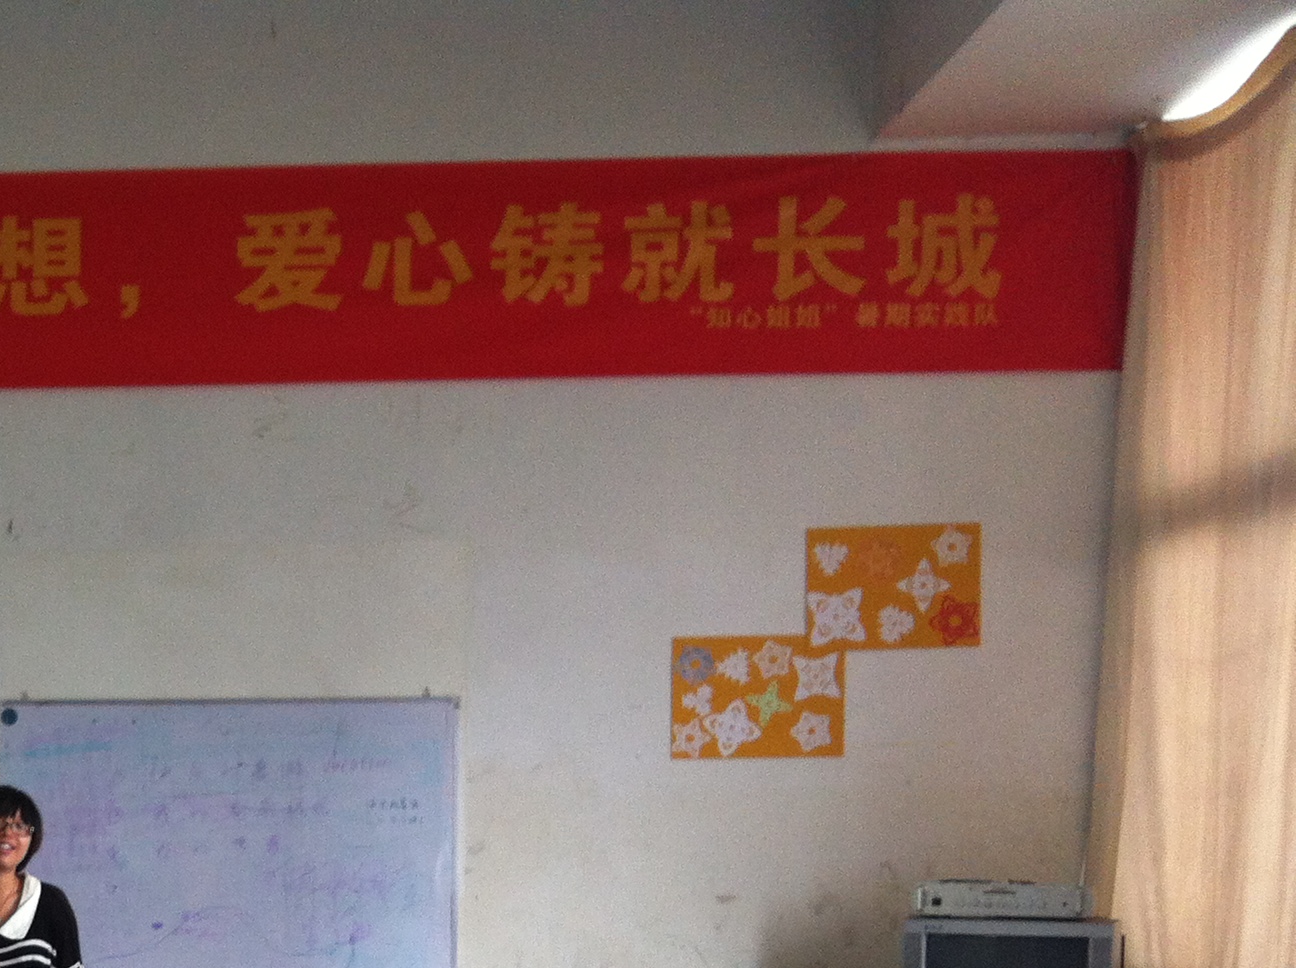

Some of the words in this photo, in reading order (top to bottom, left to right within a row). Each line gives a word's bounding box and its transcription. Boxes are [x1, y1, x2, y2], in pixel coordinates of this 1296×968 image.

[234, 194, 1003, 312] 爱心铸就长城
